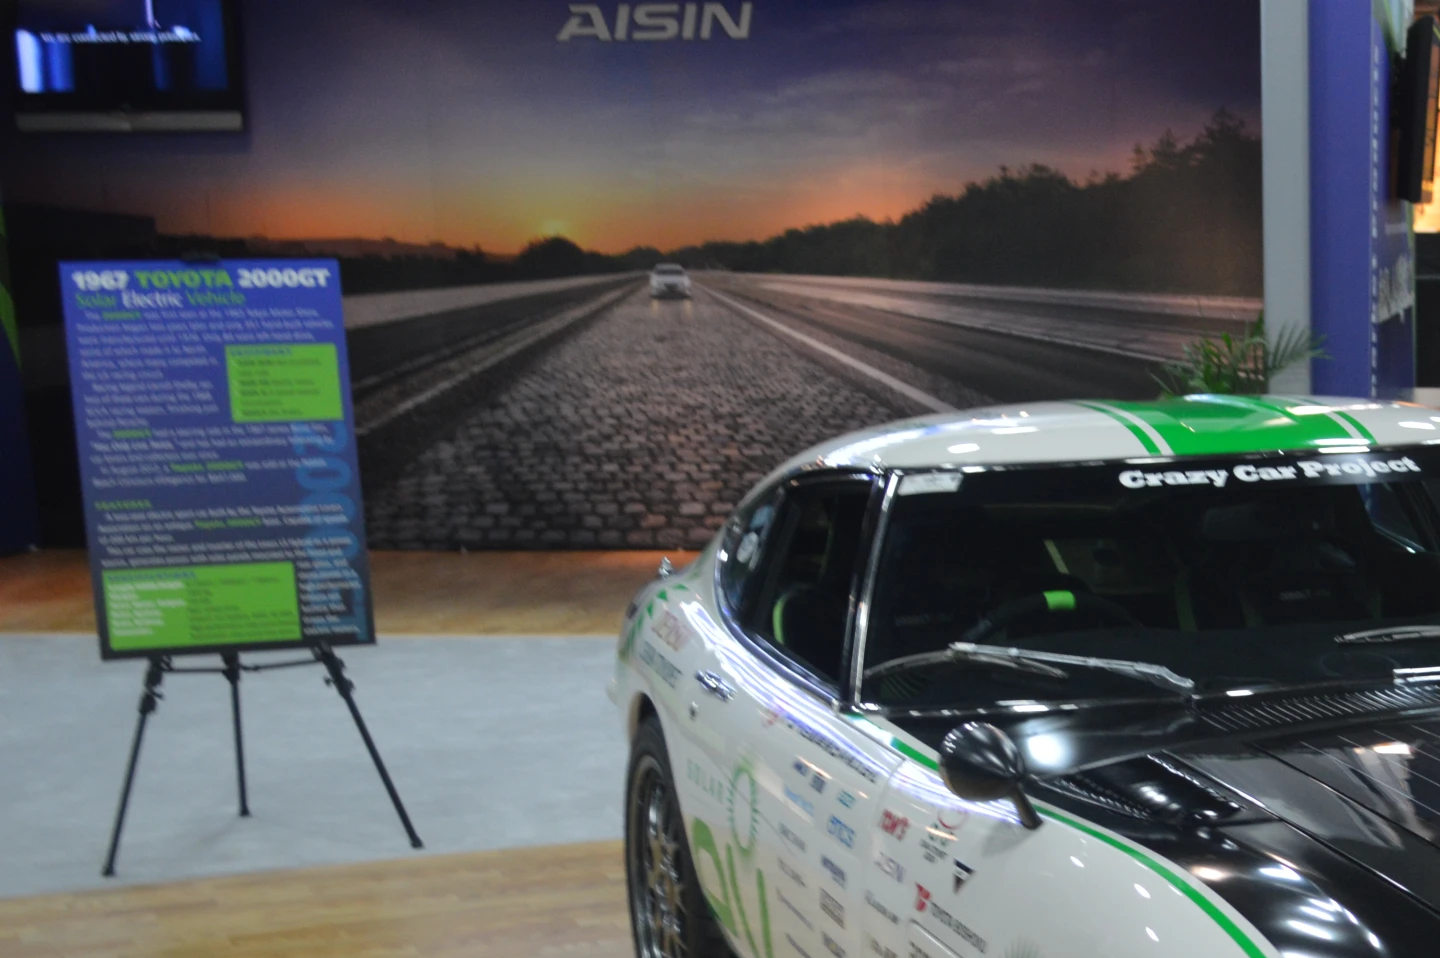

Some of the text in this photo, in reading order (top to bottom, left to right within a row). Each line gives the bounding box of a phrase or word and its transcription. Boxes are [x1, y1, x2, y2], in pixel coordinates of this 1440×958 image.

[556, 3, 752, 41] AISIN
[72, 268, 331, 291] 1967 TOYOTA 2000GT
[75, 289, 246, 309] Solar Electric Vehicle
[1119, 456, 1421, 487] Crazy Car Project
